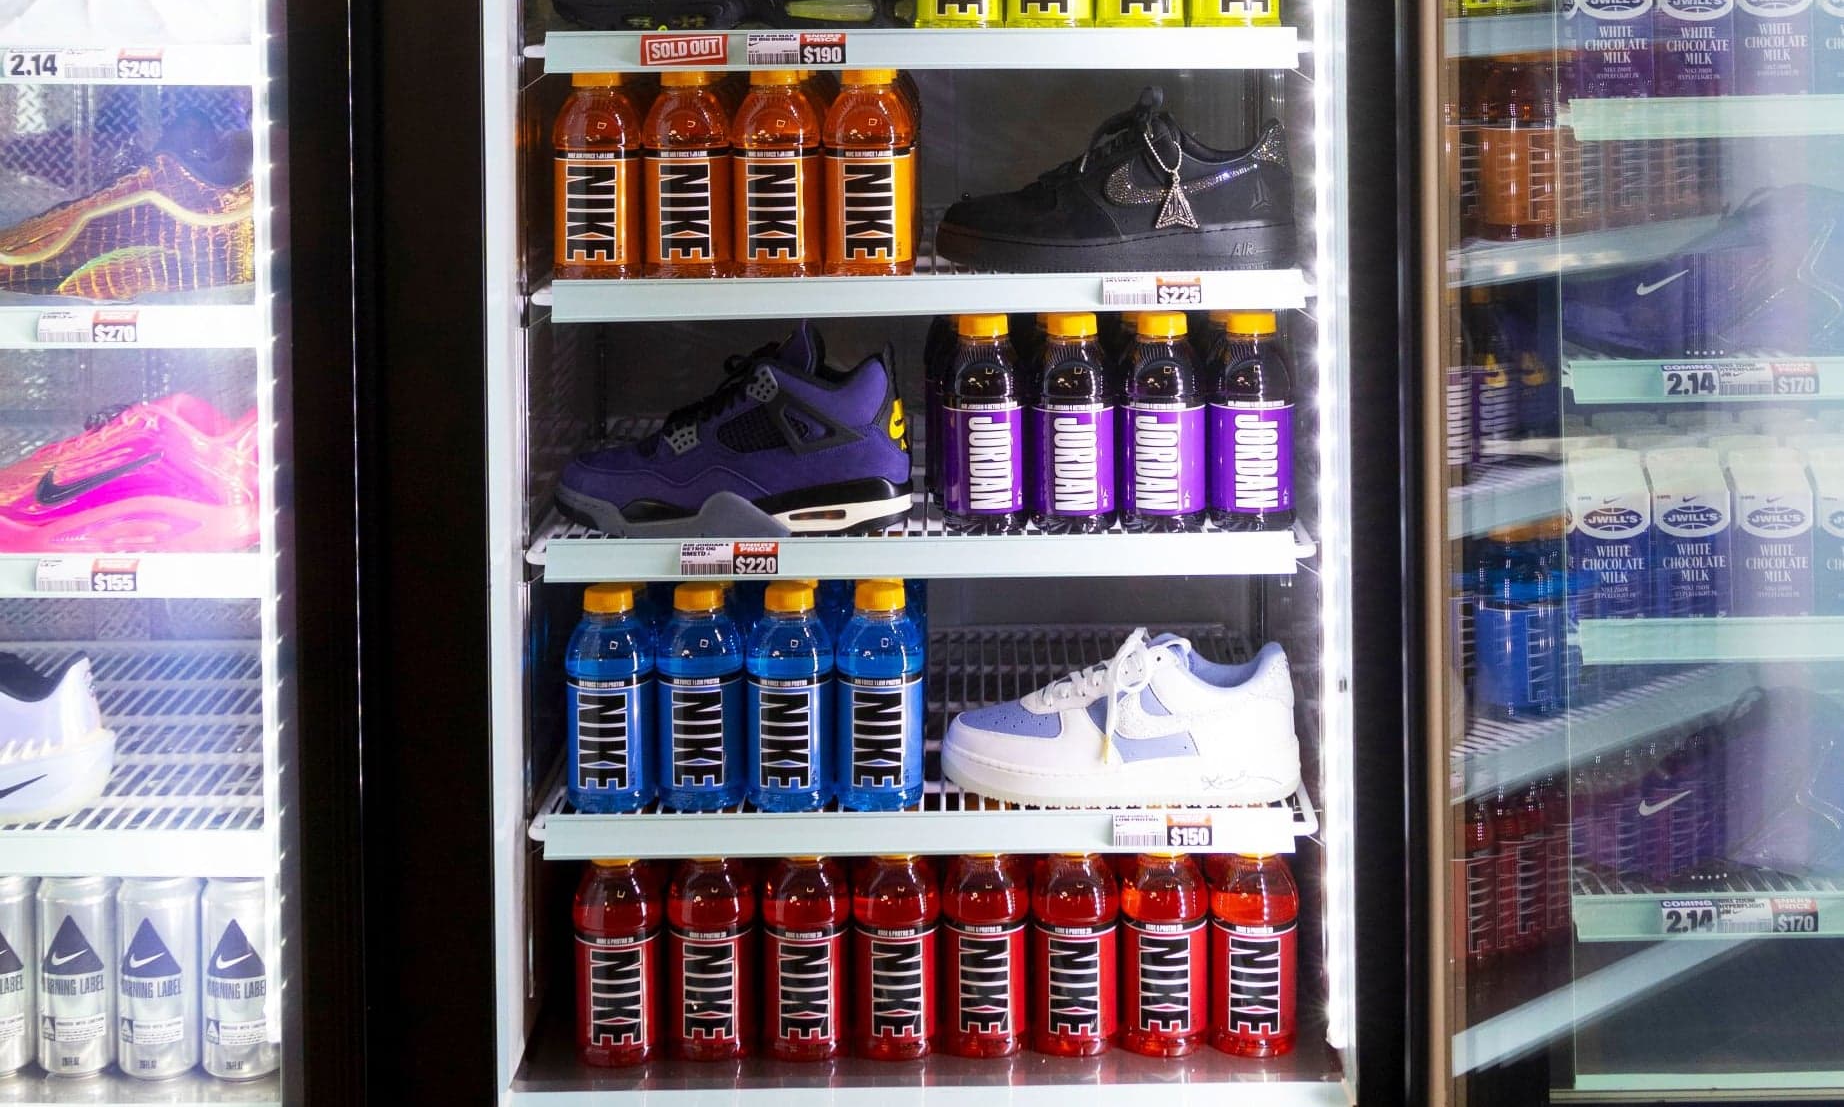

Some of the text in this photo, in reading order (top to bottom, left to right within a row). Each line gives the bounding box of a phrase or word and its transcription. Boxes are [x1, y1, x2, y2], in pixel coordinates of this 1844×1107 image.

[1600, 25, 1634, 37] WHITE
[1680, 27, 1716, 39] WHITE
[1758, 23, 1792, 35] WHITE
[651, 39, 718, 59] SOLD OUT
[1584, 38, 1648, 51] CHOCOLATE
[1666, 39, 1730, 52] CHOCOLATE
[1744, 35, 1808, 48] CHOCOLATE
[803, 46, 842, 64] $190
[1603, 51, 1632, 63] MILK
[1684, 53, 1712, 65] MILK
[1763, 49, 1791, 61] MILK
[10, 54, 58, 76] 2.14
[119, 59, 162, 79] $240
[566, 164, 616, 261] NIKE
[659, 163, 711, 259] NIKE
[747, 163, 797, 259] NIKE
[844, 163, 895, 260] NIKE
[1232, 242, 1254, 256] AIR
[1159, 286, 1200, 304] $225
[94, 324, 135, 342] $270
[1667, 373, 1716, 395] 2.14
[1778, 376, 1816, 393] $170
[968, 416, 1013, 510] JORDAN
[1054, 417, 1098, 511] JORDAN
[1135, 415, 1178, 510] JORDAN
[1235, 414, 1279, 508] JORDAN
[1588, 515, 1638, 524] JWILL'S
[1668, 513, 1718, 523] JWILL'S
[1751, 514, 1802, 523] JWILL'S
[1596, 545, 1632, 558] WHITE
[1676, 543, 1712, 557] WHITE
[1760, 544, 1794, 557] WHITE
[736, 556, 776, 574] $220
[1582, 557, 1645, 570] CHOCOLATE
[1662, 555, 1726, 569] CHOCOLATE
[1745, 557, 1808, 569] CHOCOLATE
[94, 573, 134, 591] $155
[1600, 571, 1628, 583] MILK
[1681, 569, 1710, 582] MILK
[1764, 571, 1792, 582] MILK
[577, 693, 627, 790] NIKE
[672, 689, 724, 787] NIKE
[760, 691, 810, 788] NIKE
[852, 690, 903, 788] NIKE
[1170, 827, 1210, 846] $150
[1666, 910, 1715, 933] 2.14
[1778, 913, 1814, 932] $170
[80, 975, 104, 993] LABEL
[156, 977, 182, 998] LABEL
[683, 942, 735, 1039] NIKE
[779, 941, 830, 1039] NIKE
[871, 940, 923, 1038] NIKE
[959, 935, 1010, 1034] NIKE
[1049, 938, 1100, 1036] NIKE
[1139, 935, 1190, 1032] NIKE
[1229, 936, 1280, 1035] NIKE
[590, 947, 643, 1046] NIKE
